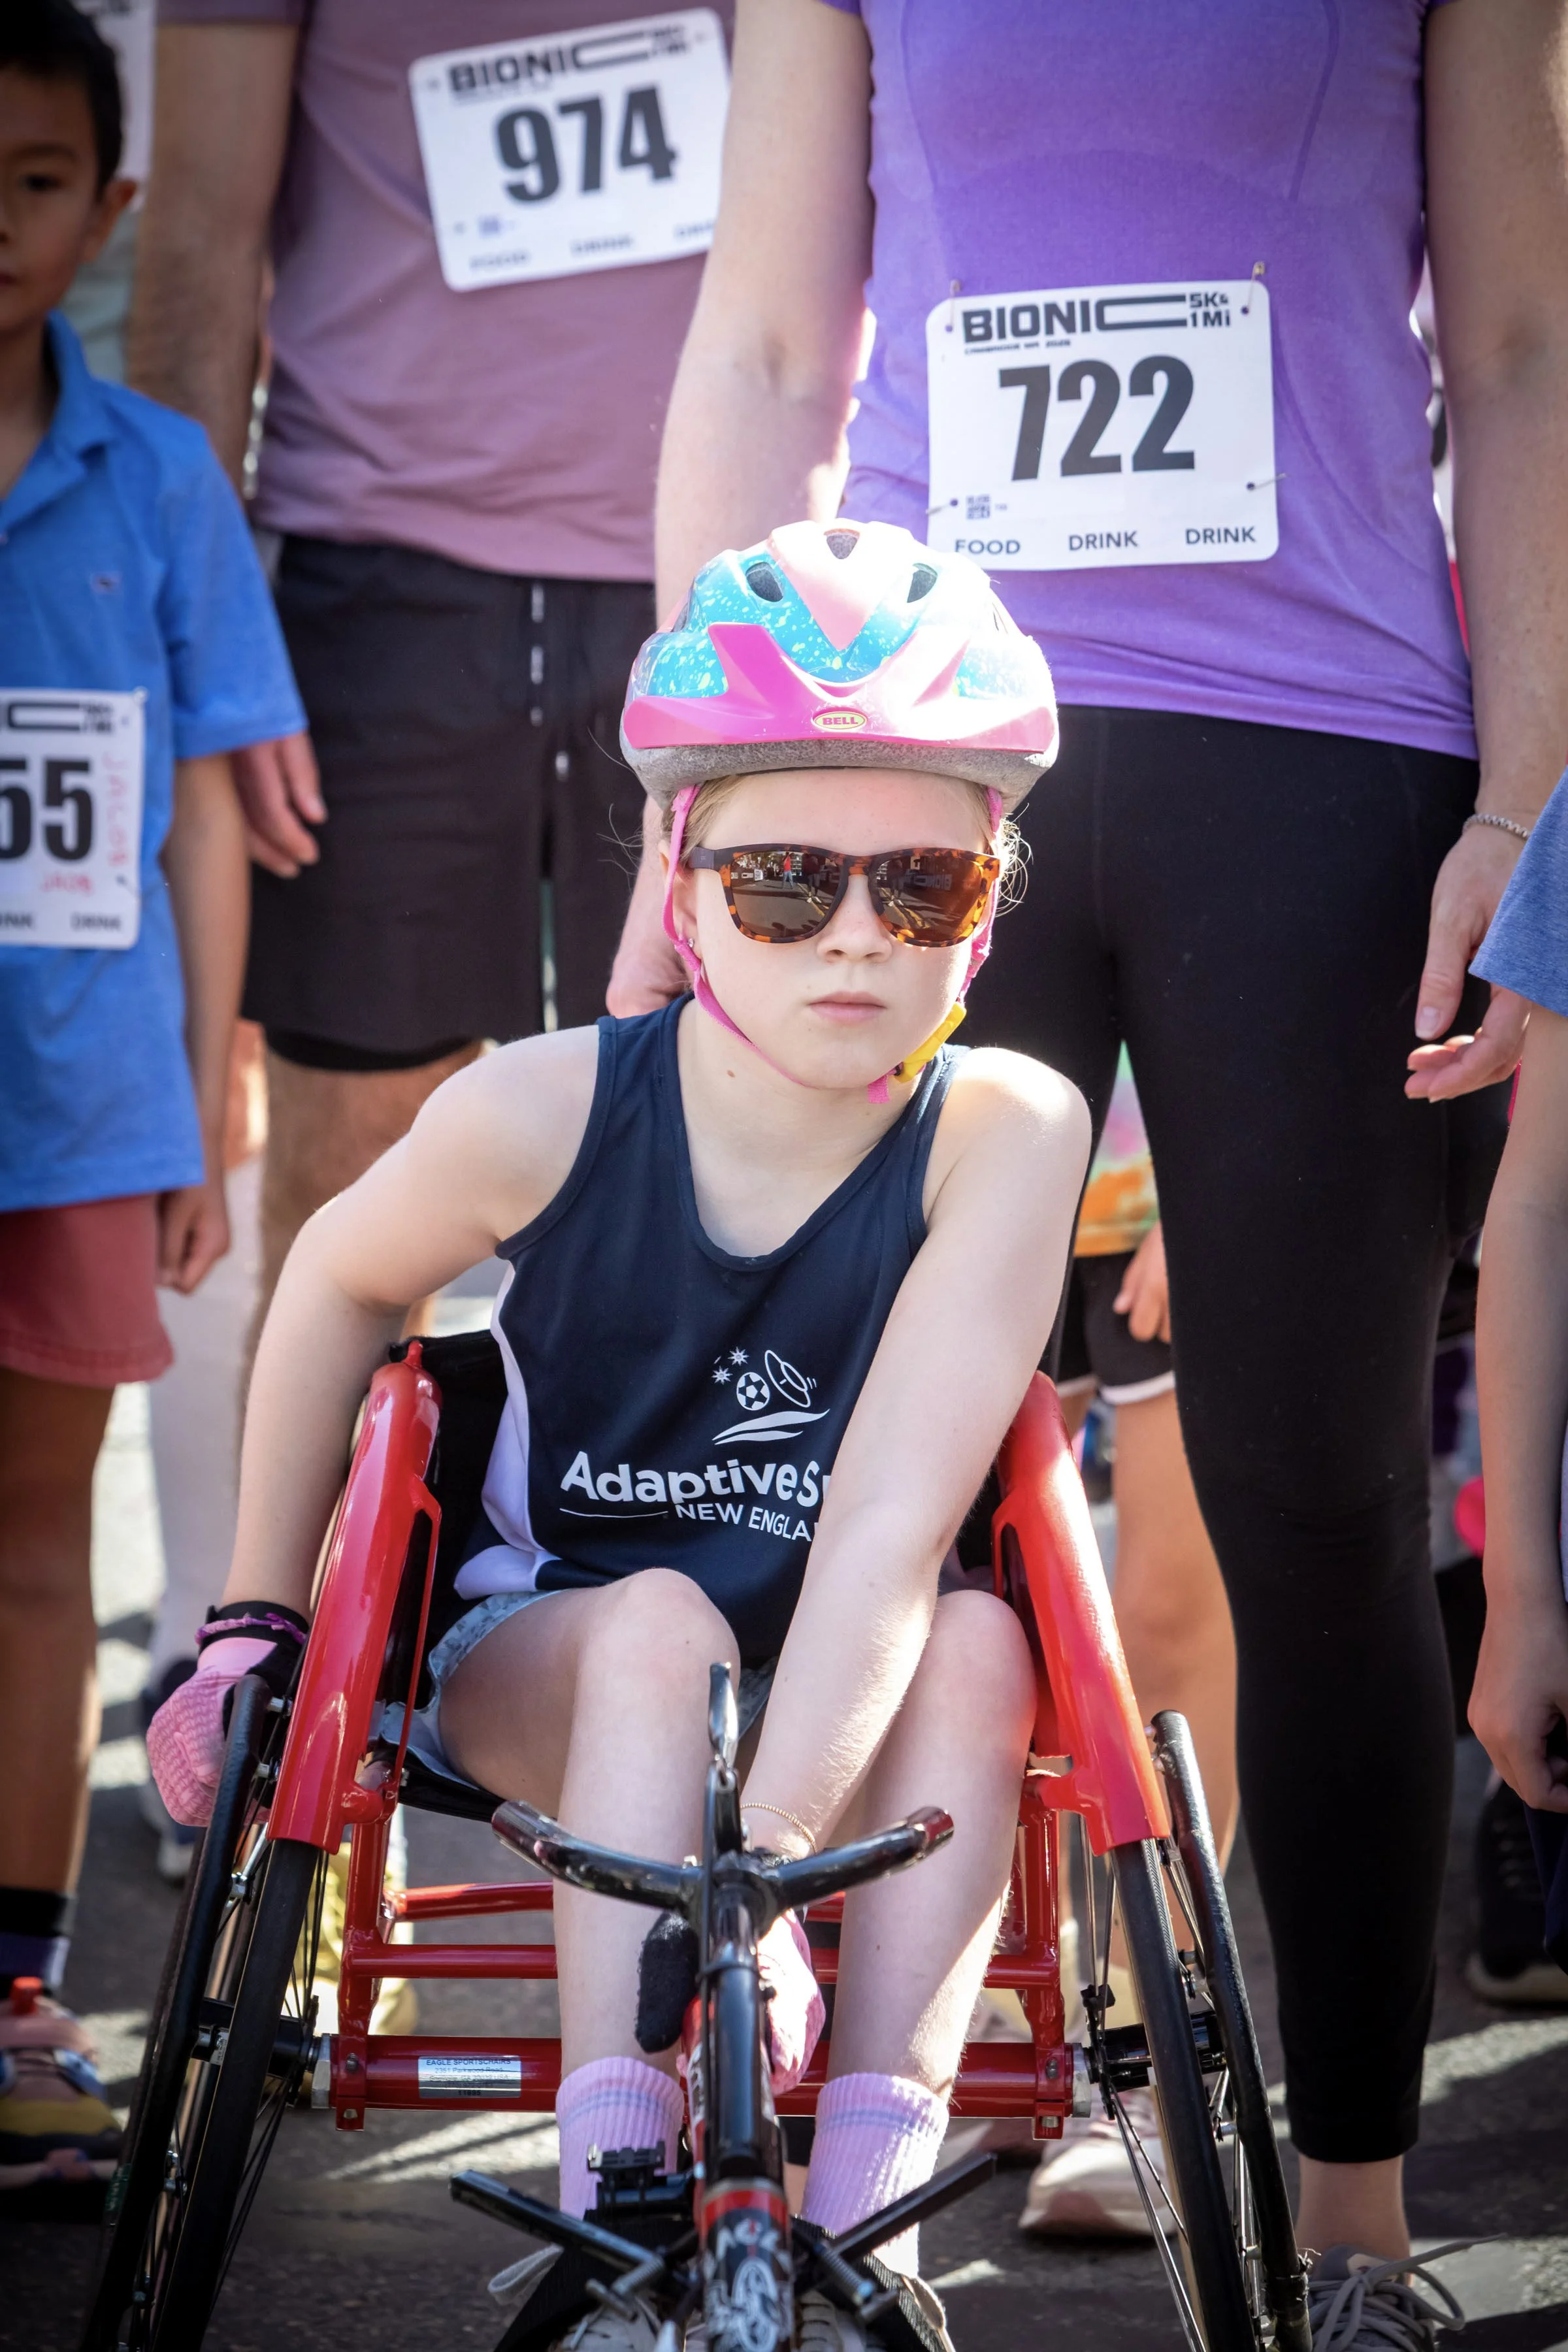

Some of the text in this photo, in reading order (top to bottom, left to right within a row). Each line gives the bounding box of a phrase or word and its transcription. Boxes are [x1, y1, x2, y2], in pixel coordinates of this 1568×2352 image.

[449, 31, 650, 91] BIONIC
[497, 86, 677, 203] 974
[962, 294, 1187, 343] BIONIC
[998, 355, 1195, 482] 722
[955, 527, 1256, 555] FOOD DRINK DRINK
[822, 717, 858, 725] BELL
[0, 758, 92, 862] 55
[675, 1503, 819, 1542] NEW ENGLA
